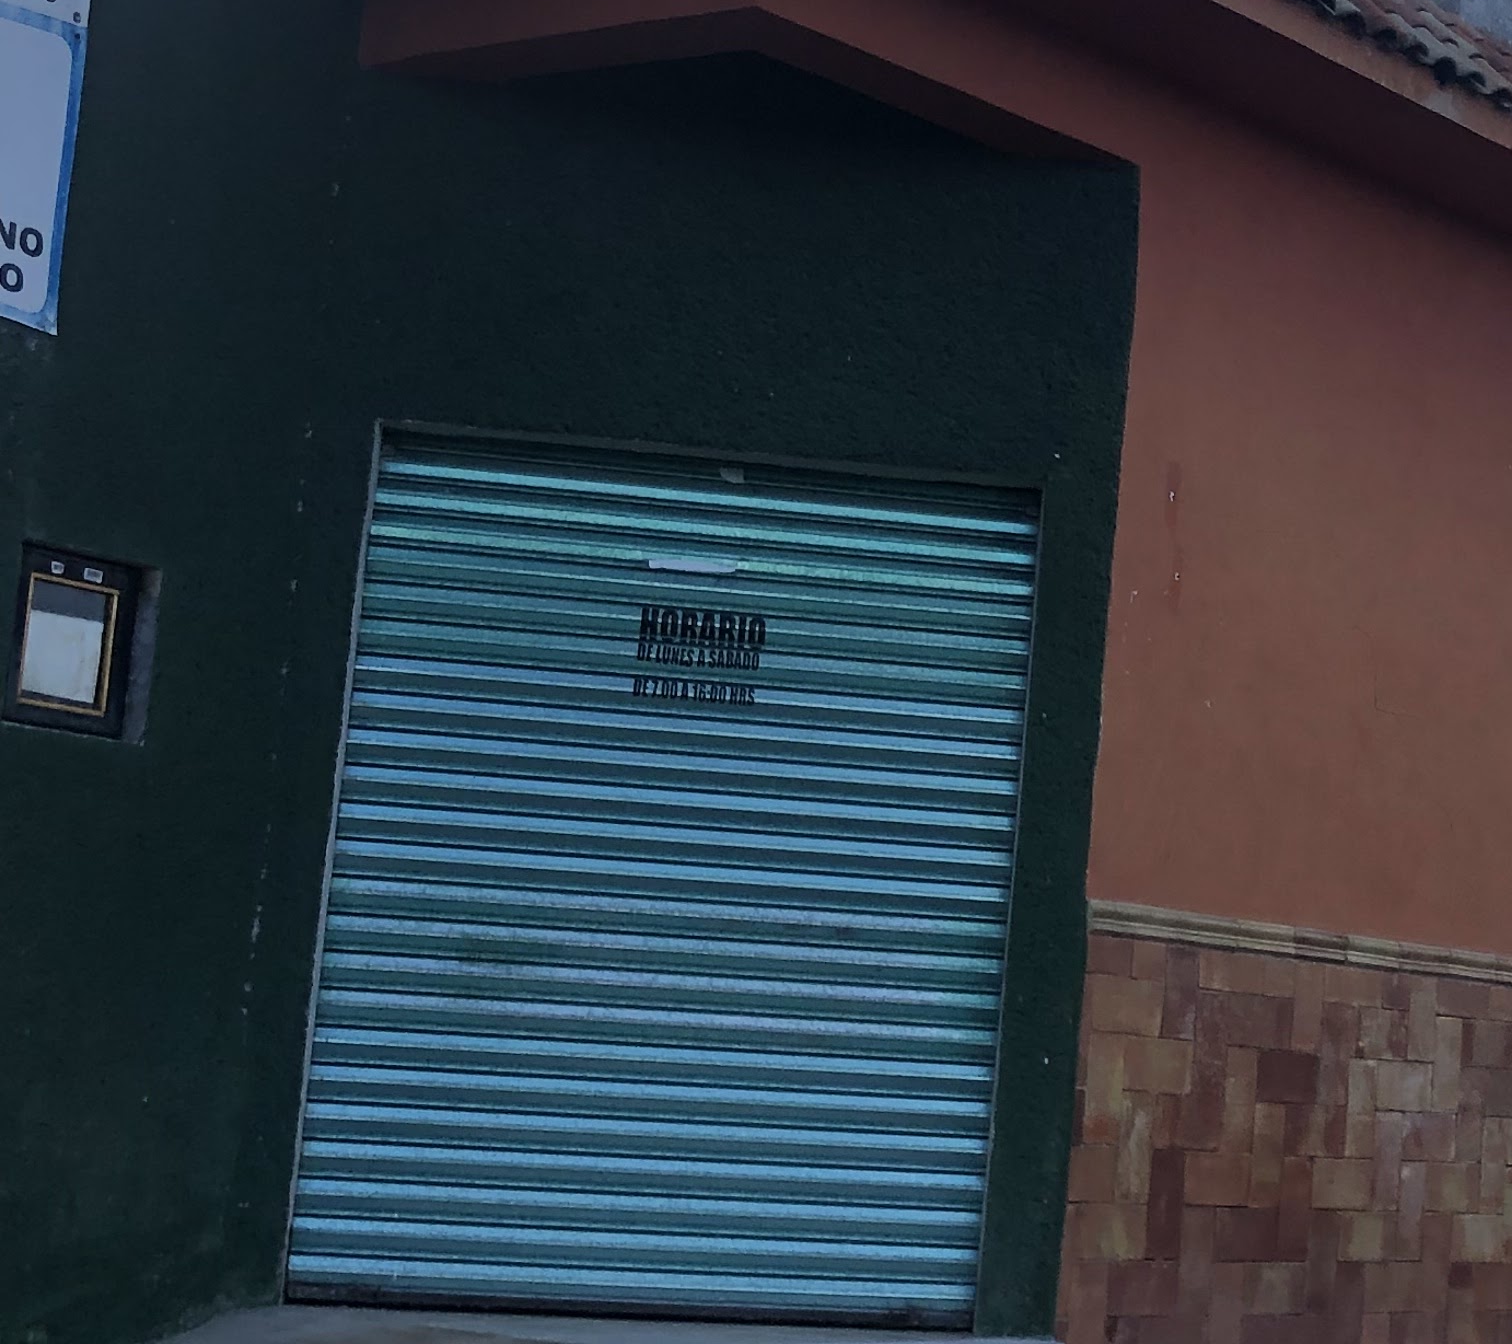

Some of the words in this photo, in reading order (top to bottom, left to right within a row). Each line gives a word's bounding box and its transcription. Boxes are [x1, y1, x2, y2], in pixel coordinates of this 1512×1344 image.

[640, 607, 766, 651] HORARIO
[637, 642, 652, 661] DE
[656, 644, 695, 667] LUNES
[697, 649, 706, 667] A
[708, 650, 760, 671] SABADO
[633, 678, 649, 697] DE
[681, 681, 690, 700] A
[730, 686, 755, 706] HRS
